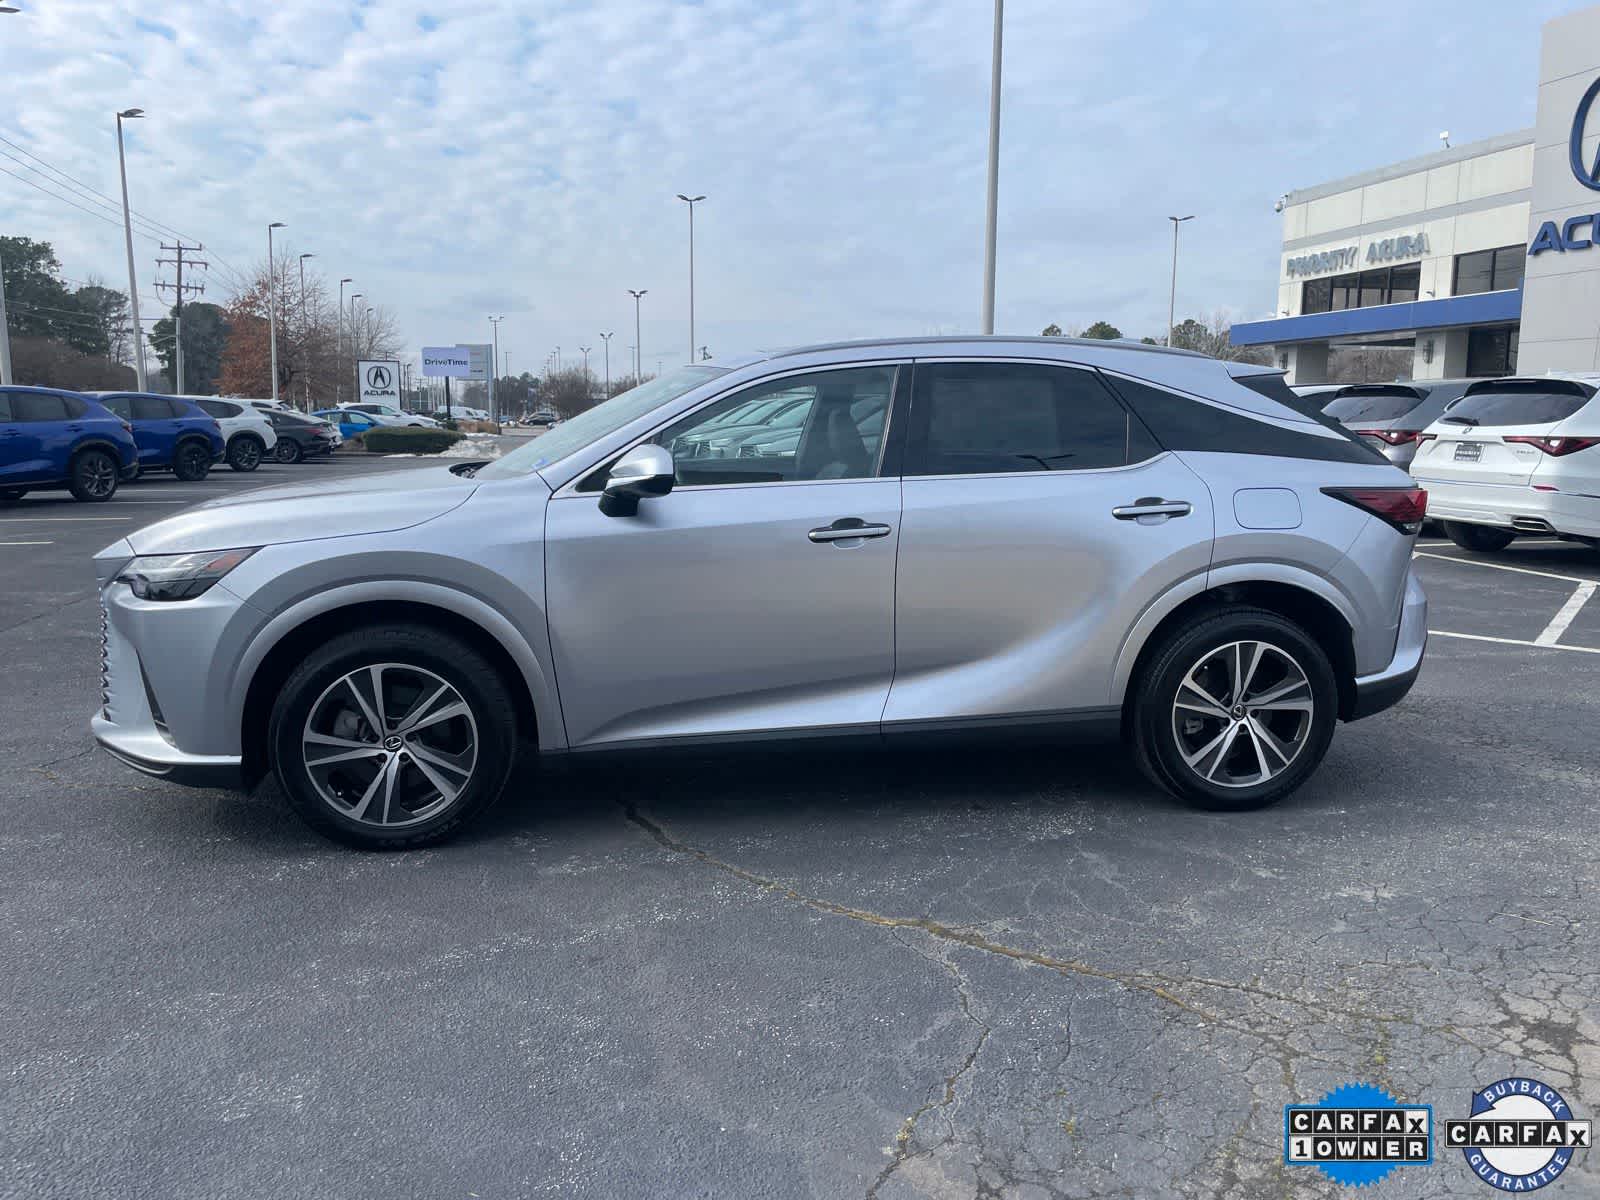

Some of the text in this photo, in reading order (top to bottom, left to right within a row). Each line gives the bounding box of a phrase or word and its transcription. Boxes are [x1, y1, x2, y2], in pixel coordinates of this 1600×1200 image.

[1286, 232, 1430, 278] PRIORITY ACURA
[1528, 213, 1600, 255] AC
[424, 358, 468, 366] DriveTime
